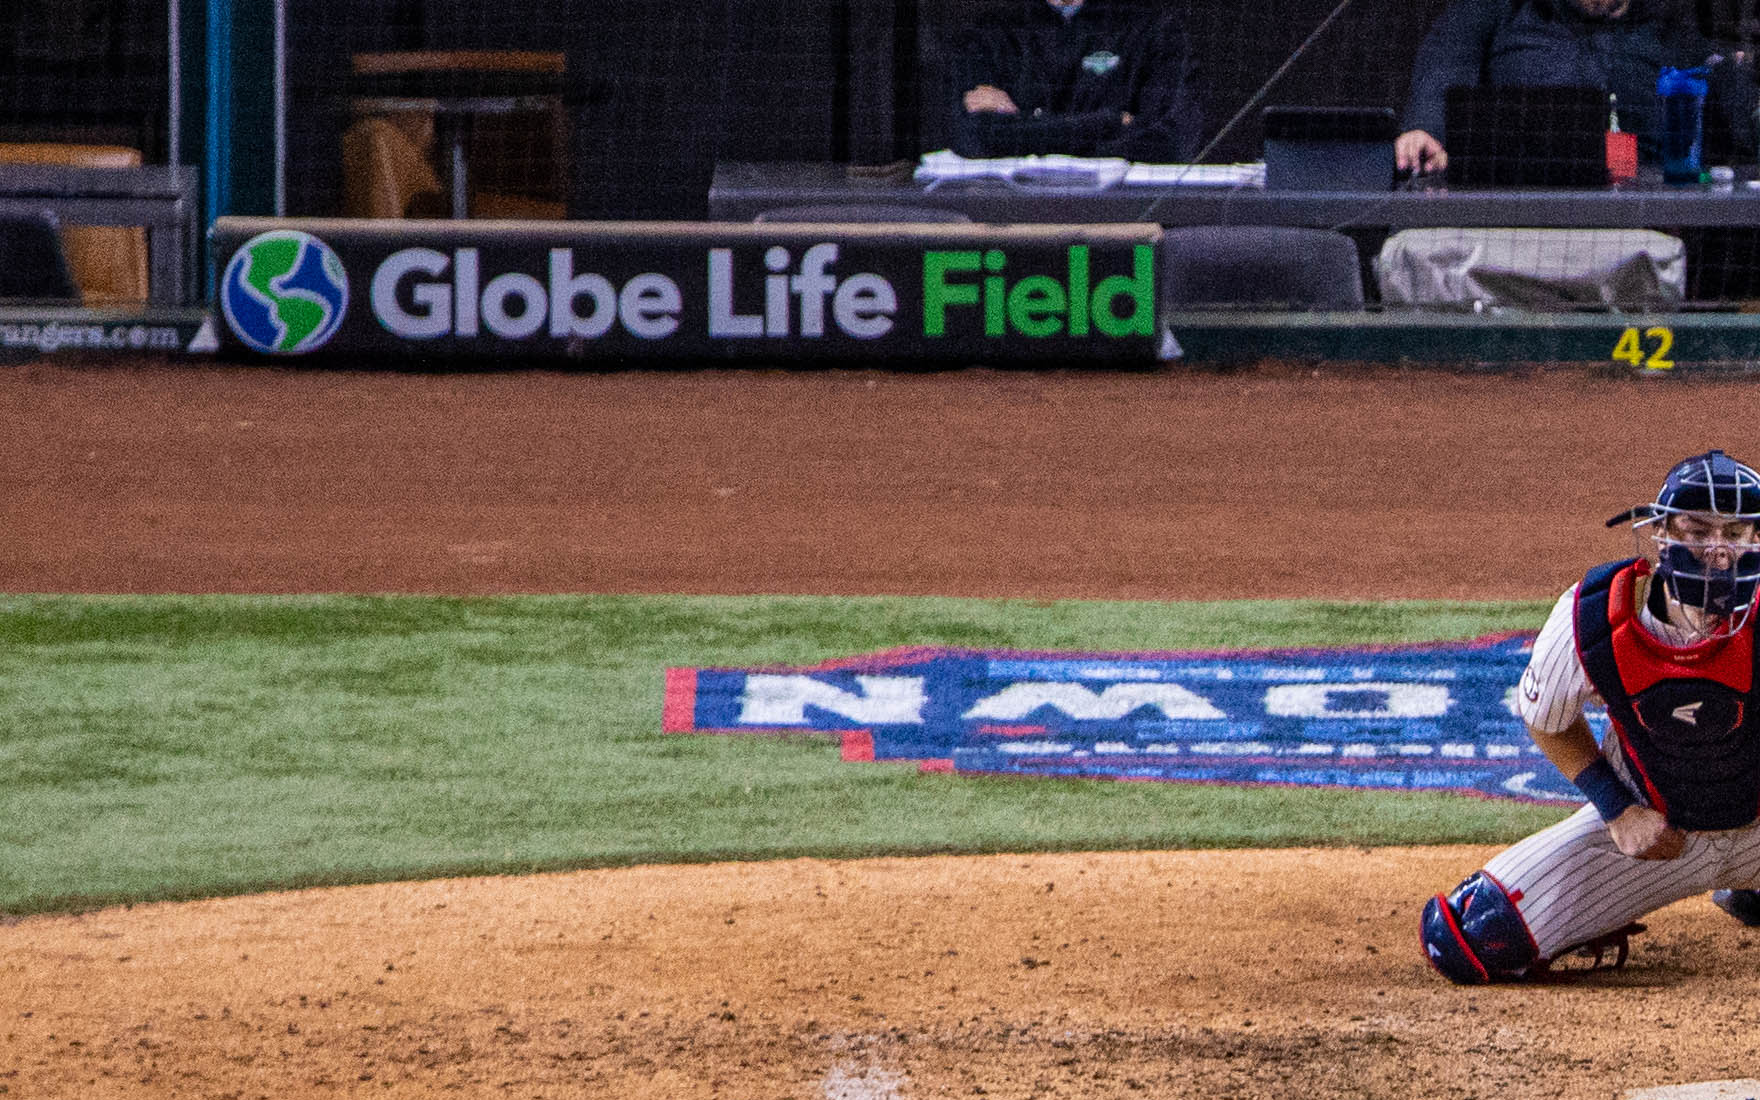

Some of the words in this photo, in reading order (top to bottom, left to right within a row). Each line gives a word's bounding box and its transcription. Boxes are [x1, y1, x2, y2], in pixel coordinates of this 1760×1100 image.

[370, 246, 683, 340] Globe
[708, 242, 898, 339] Life
[922, 244, 1156, 338] Field
[1611, 326, 1675, 369] 42
